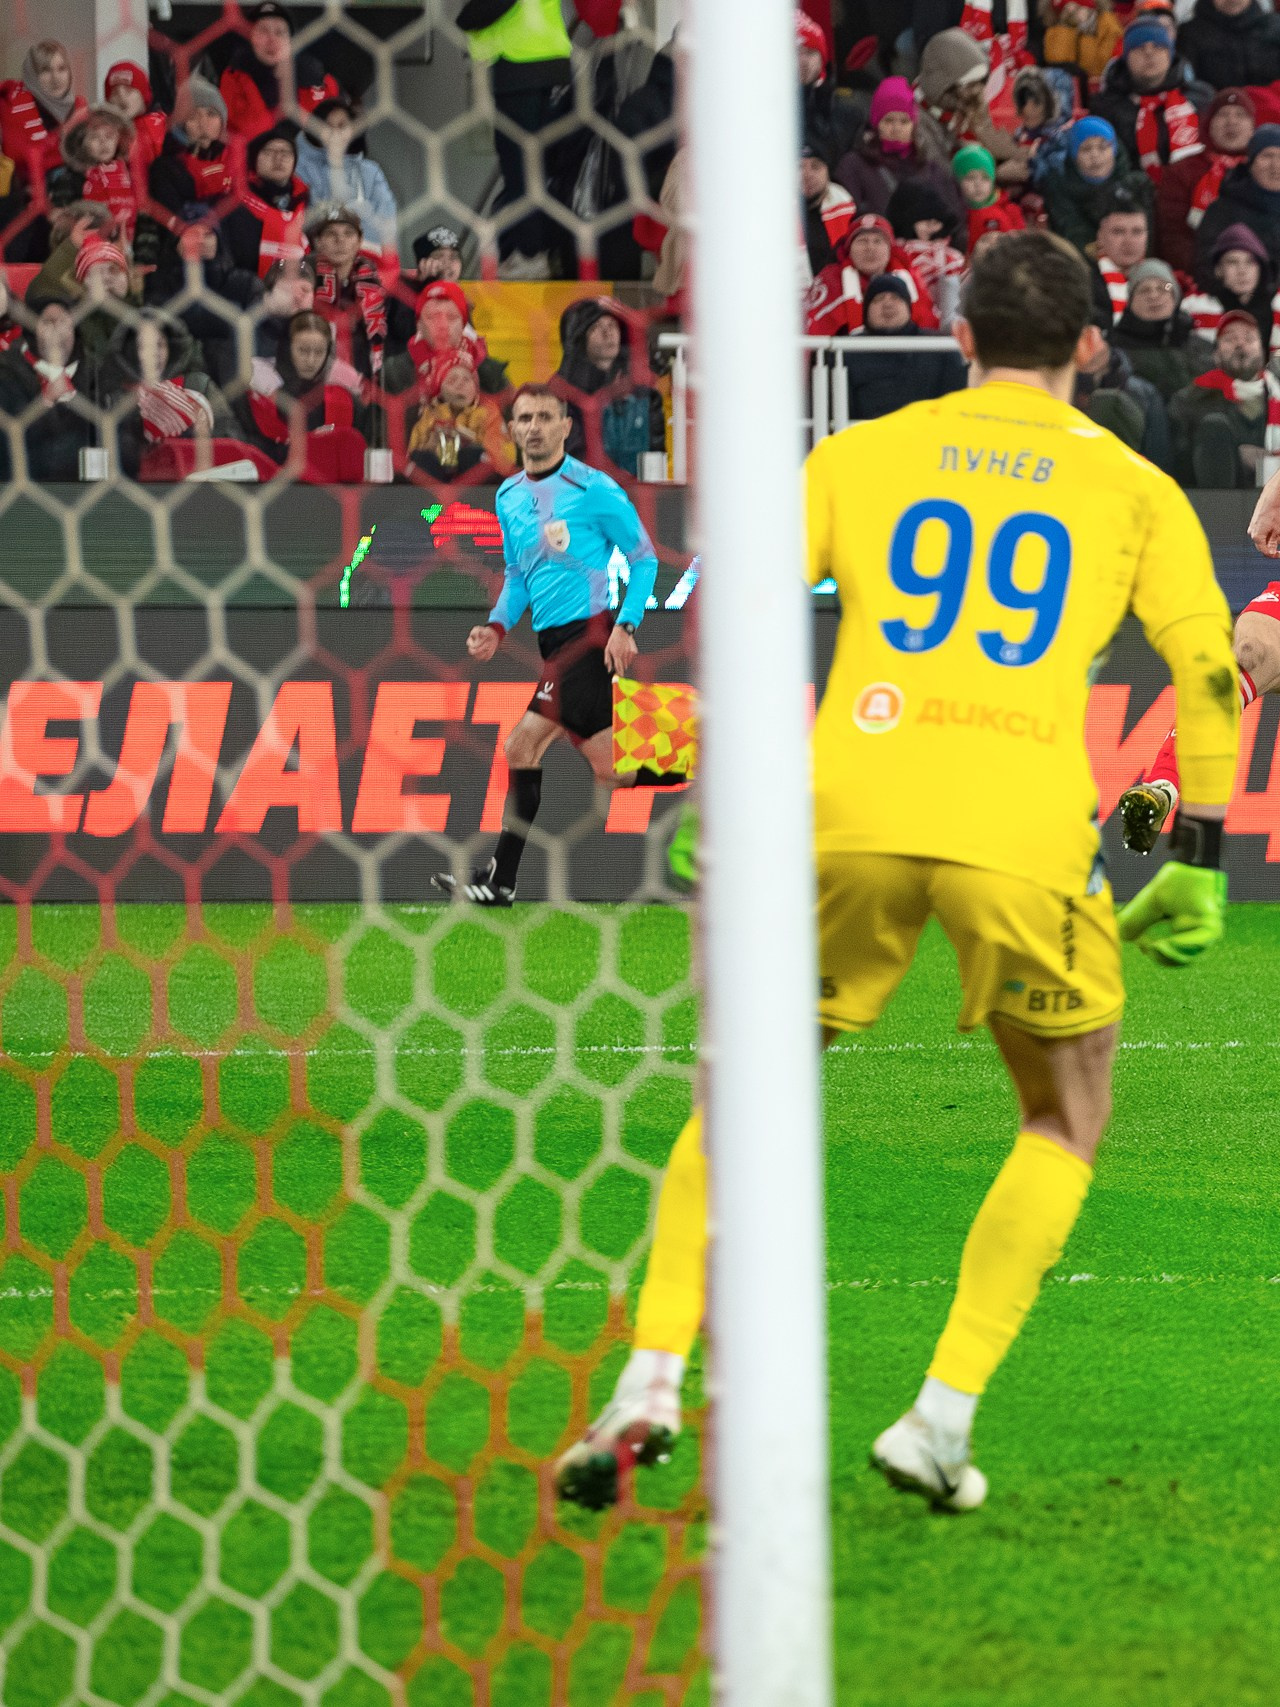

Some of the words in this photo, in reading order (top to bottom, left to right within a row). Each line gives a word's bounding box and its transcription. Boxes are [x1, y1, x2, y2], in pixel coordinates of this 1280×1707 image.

[939, 445, 1055, 484] ЛУНЁВ
[880, 498, 1074, 667] 99
[1028, 988, 1085, 1013] ВТБ
